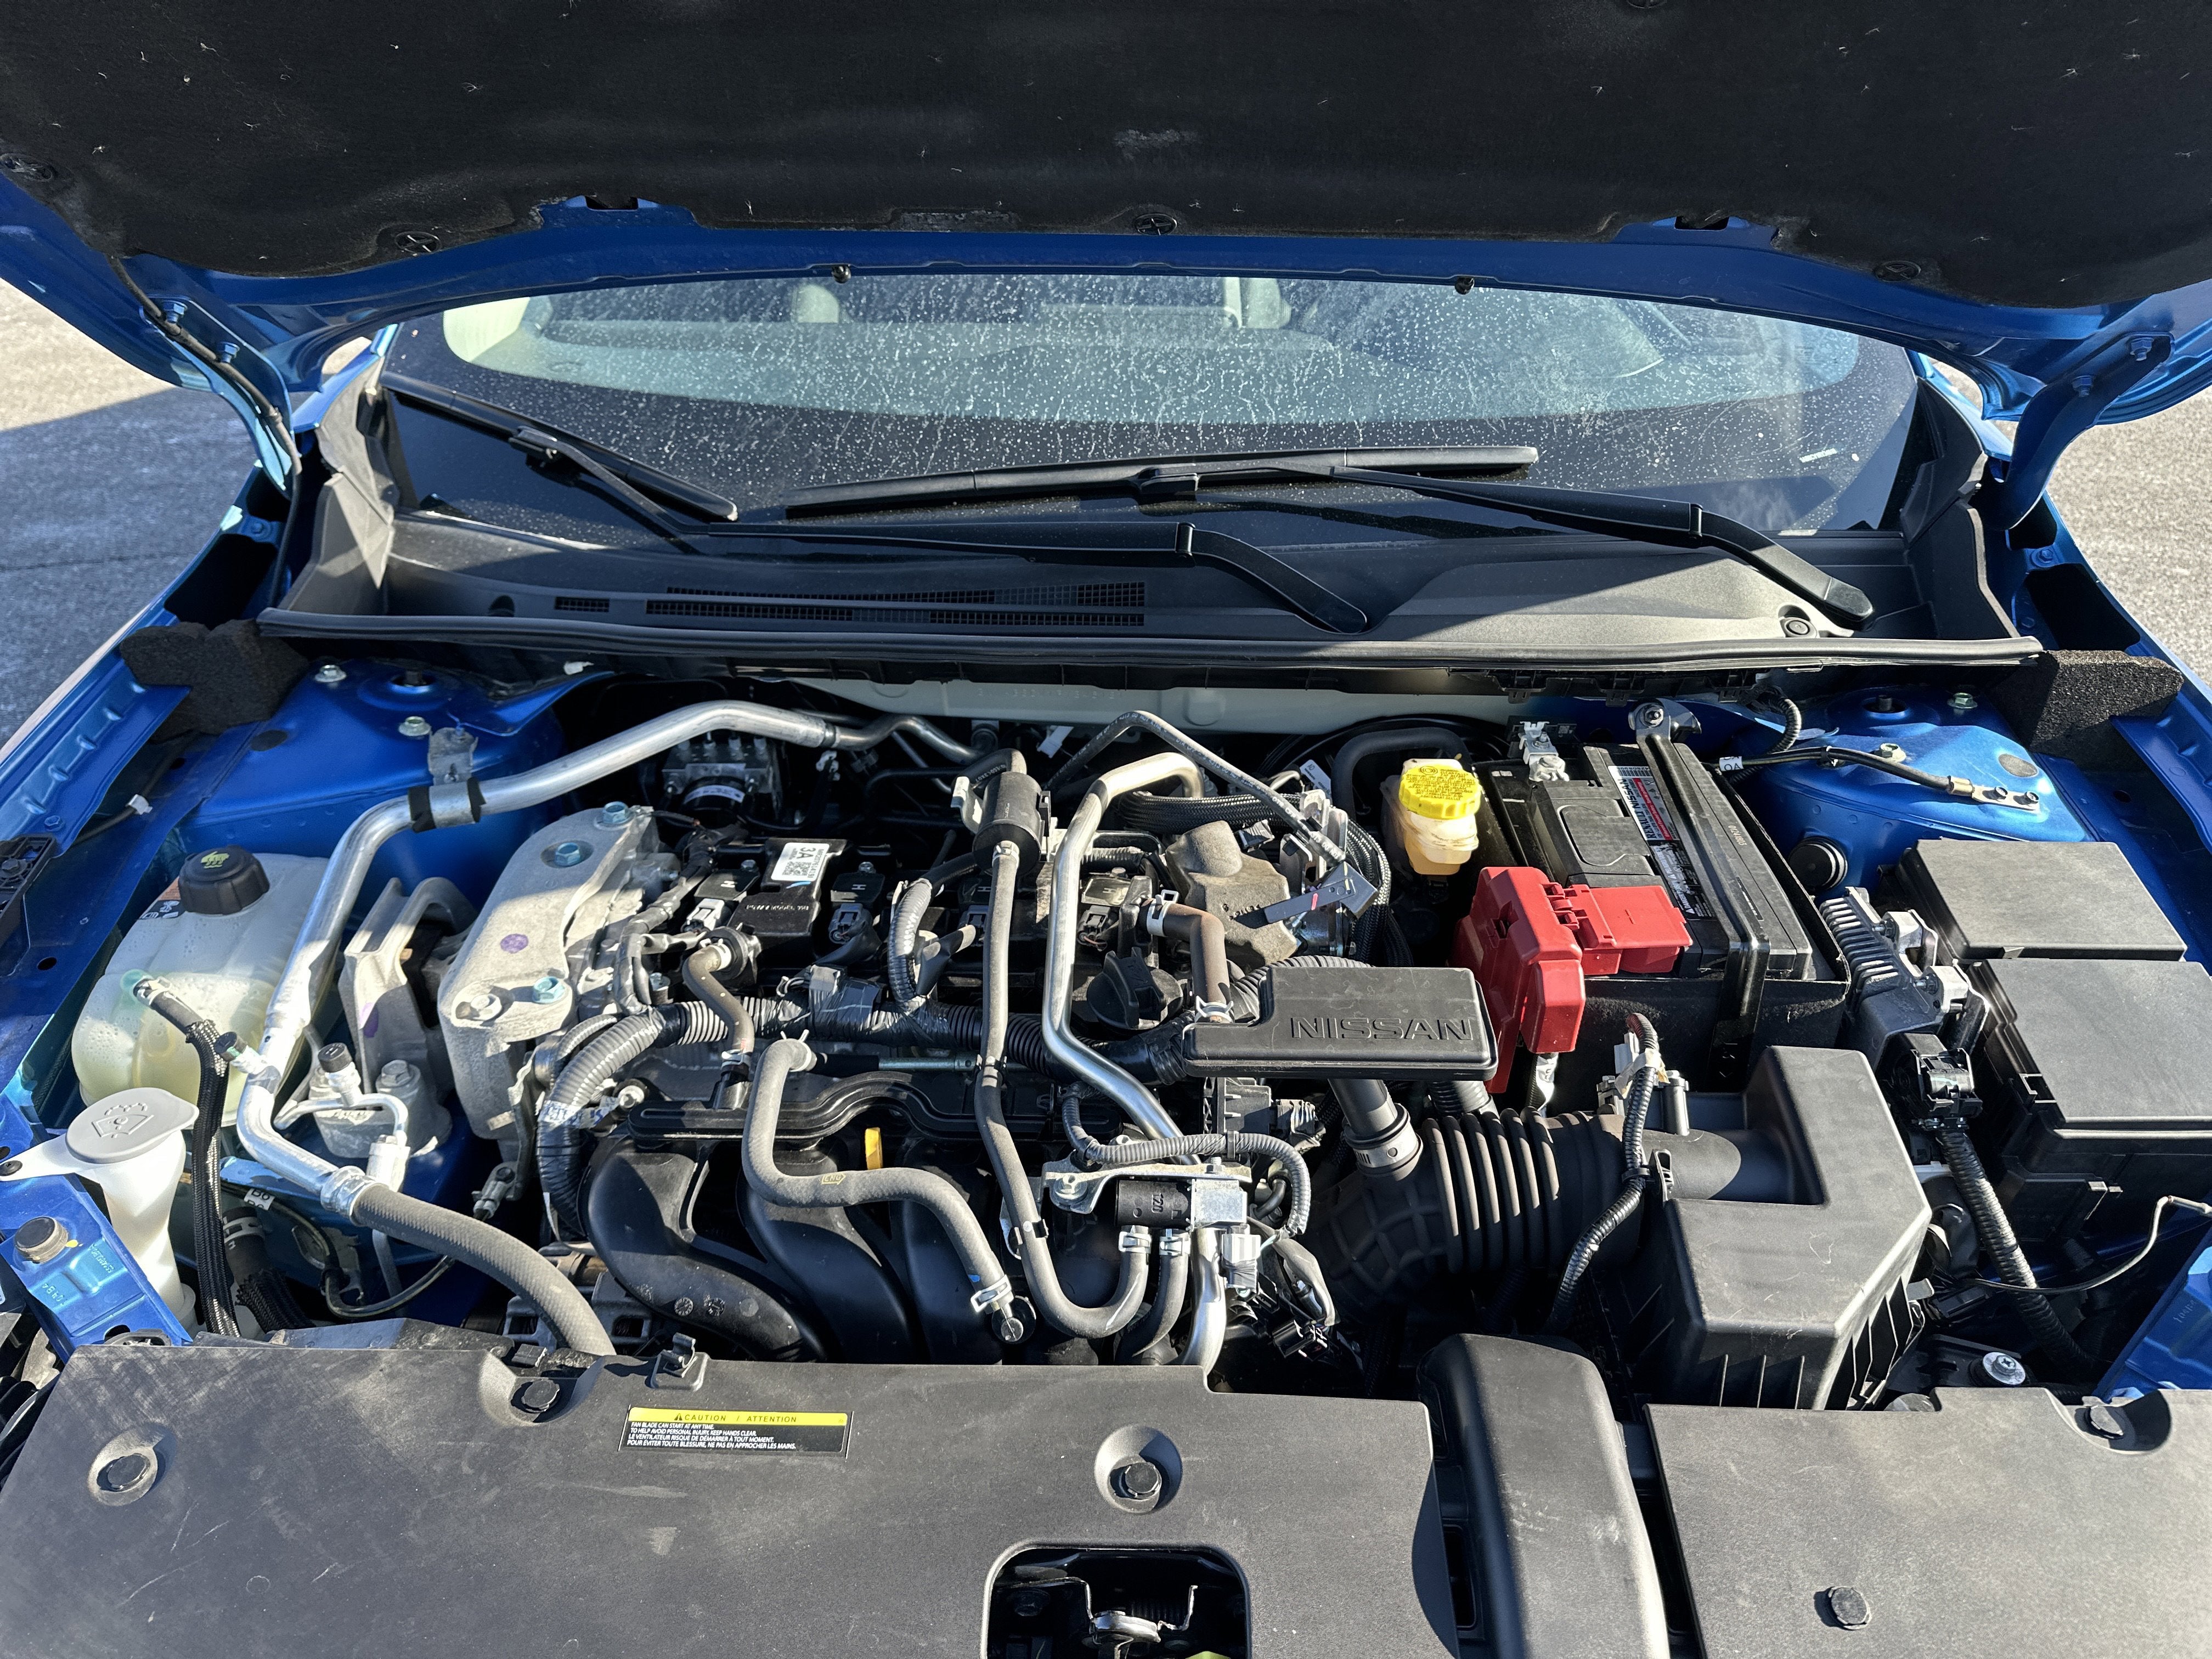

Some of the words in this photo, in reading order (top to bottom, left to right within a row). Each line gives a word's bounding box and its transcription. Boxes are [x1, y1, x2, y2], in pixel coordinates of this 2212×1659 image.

[1618, 779, 1640, 808] NISSAN
[1634, 811, 1657, 839] RENAULT
[797, 847, 816, 859] 3A
[1291, 1017, 1474, 1041] NISSAN
